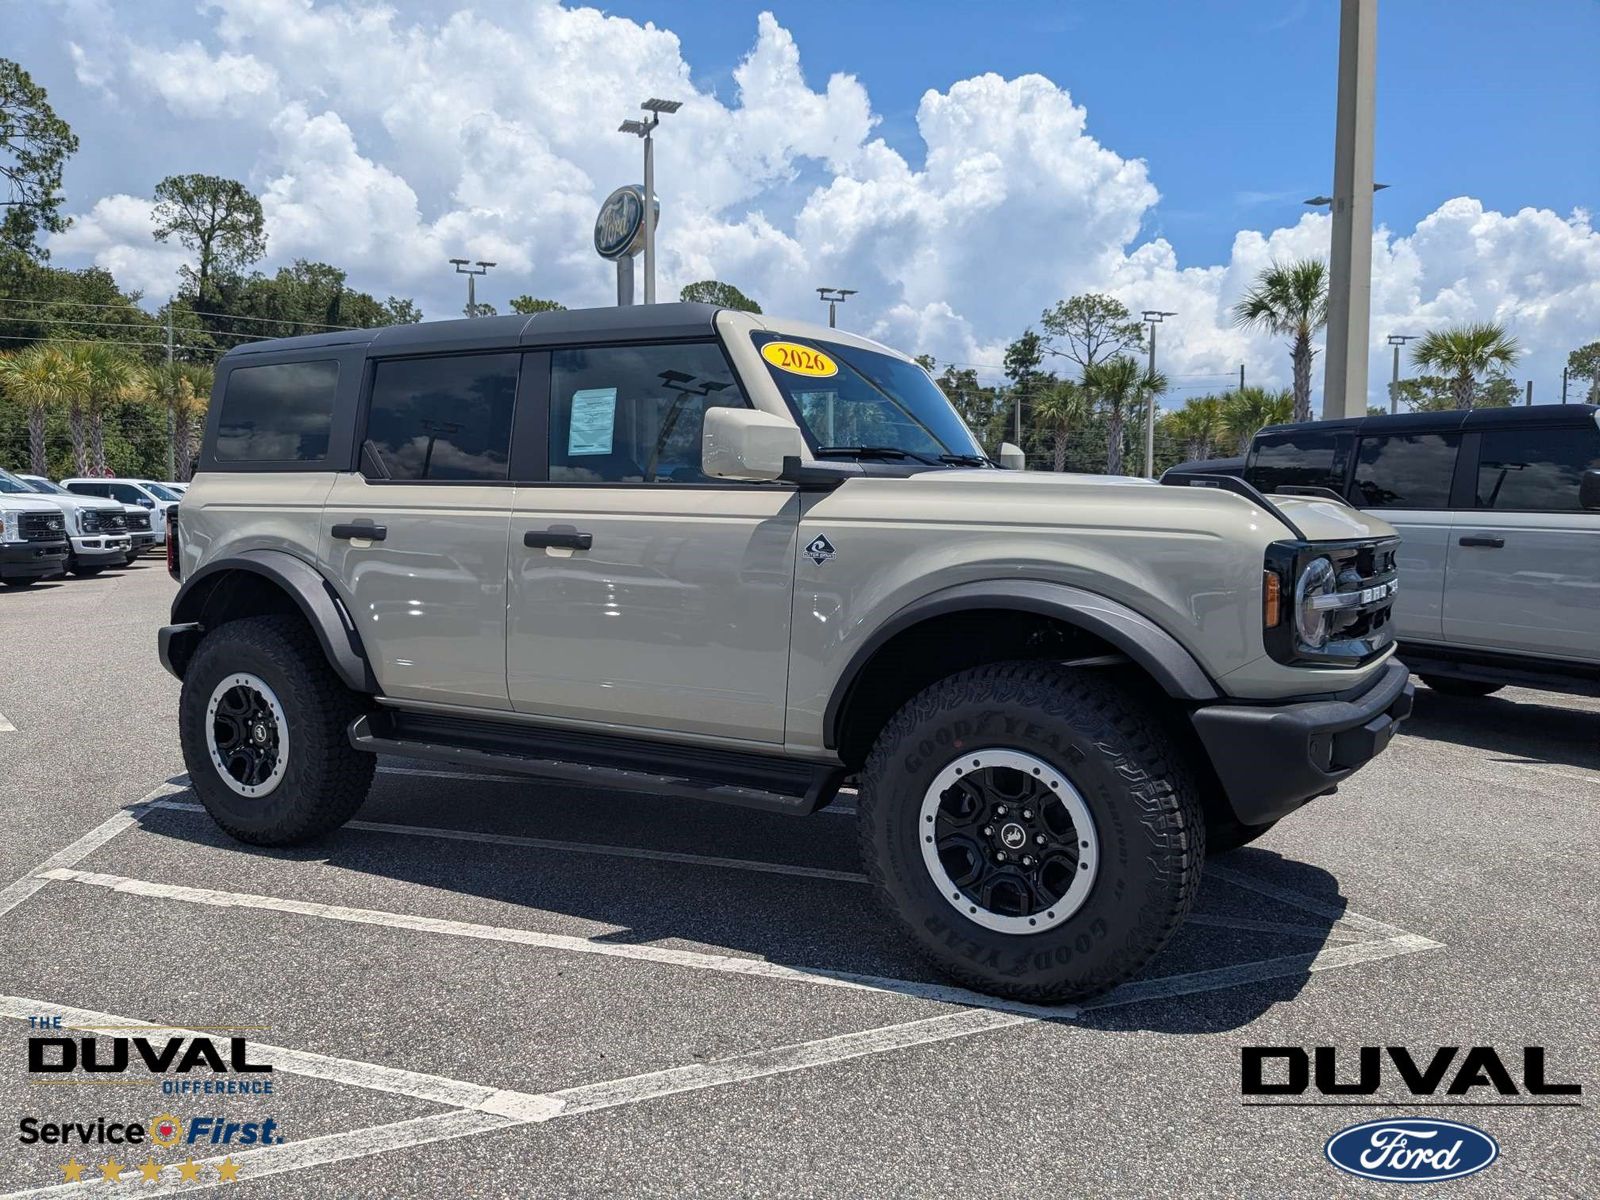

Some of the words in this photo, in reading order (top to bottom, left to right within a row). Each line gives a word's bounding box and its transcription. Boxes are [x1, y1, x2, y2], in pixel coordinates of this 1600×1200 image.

[600, 194, 629, 247] Ford
[778, 348, 825, 371] 2026
[904, 711, 1086, 773] GOODYEAR
